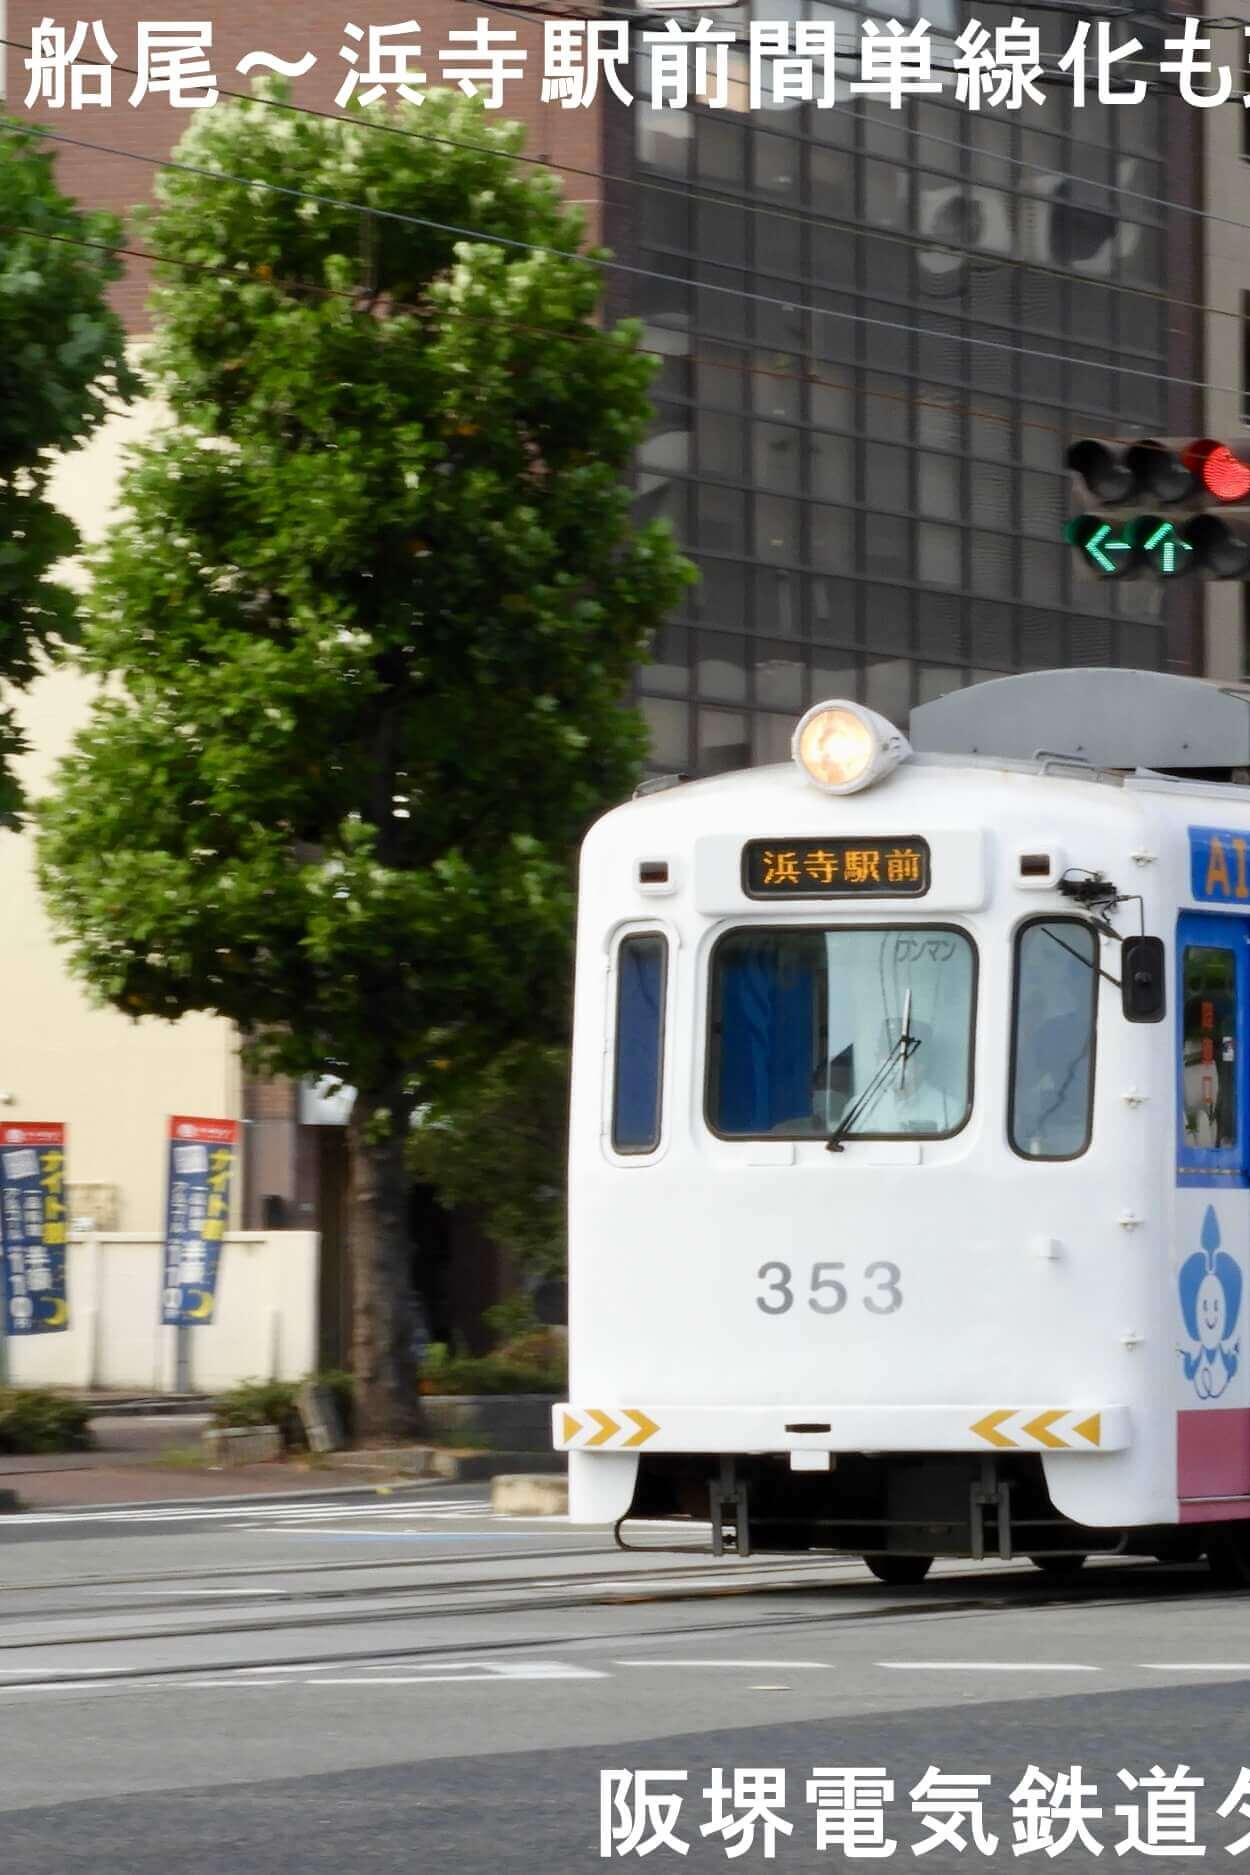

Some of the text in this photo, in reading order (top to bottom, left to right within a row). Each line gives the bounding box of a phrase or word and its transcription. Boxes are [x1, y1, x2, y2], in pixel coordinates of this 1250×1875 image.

[760, 848, 922, 885] 浜寺駅前
[757, 1260, 904, 1315] 353
